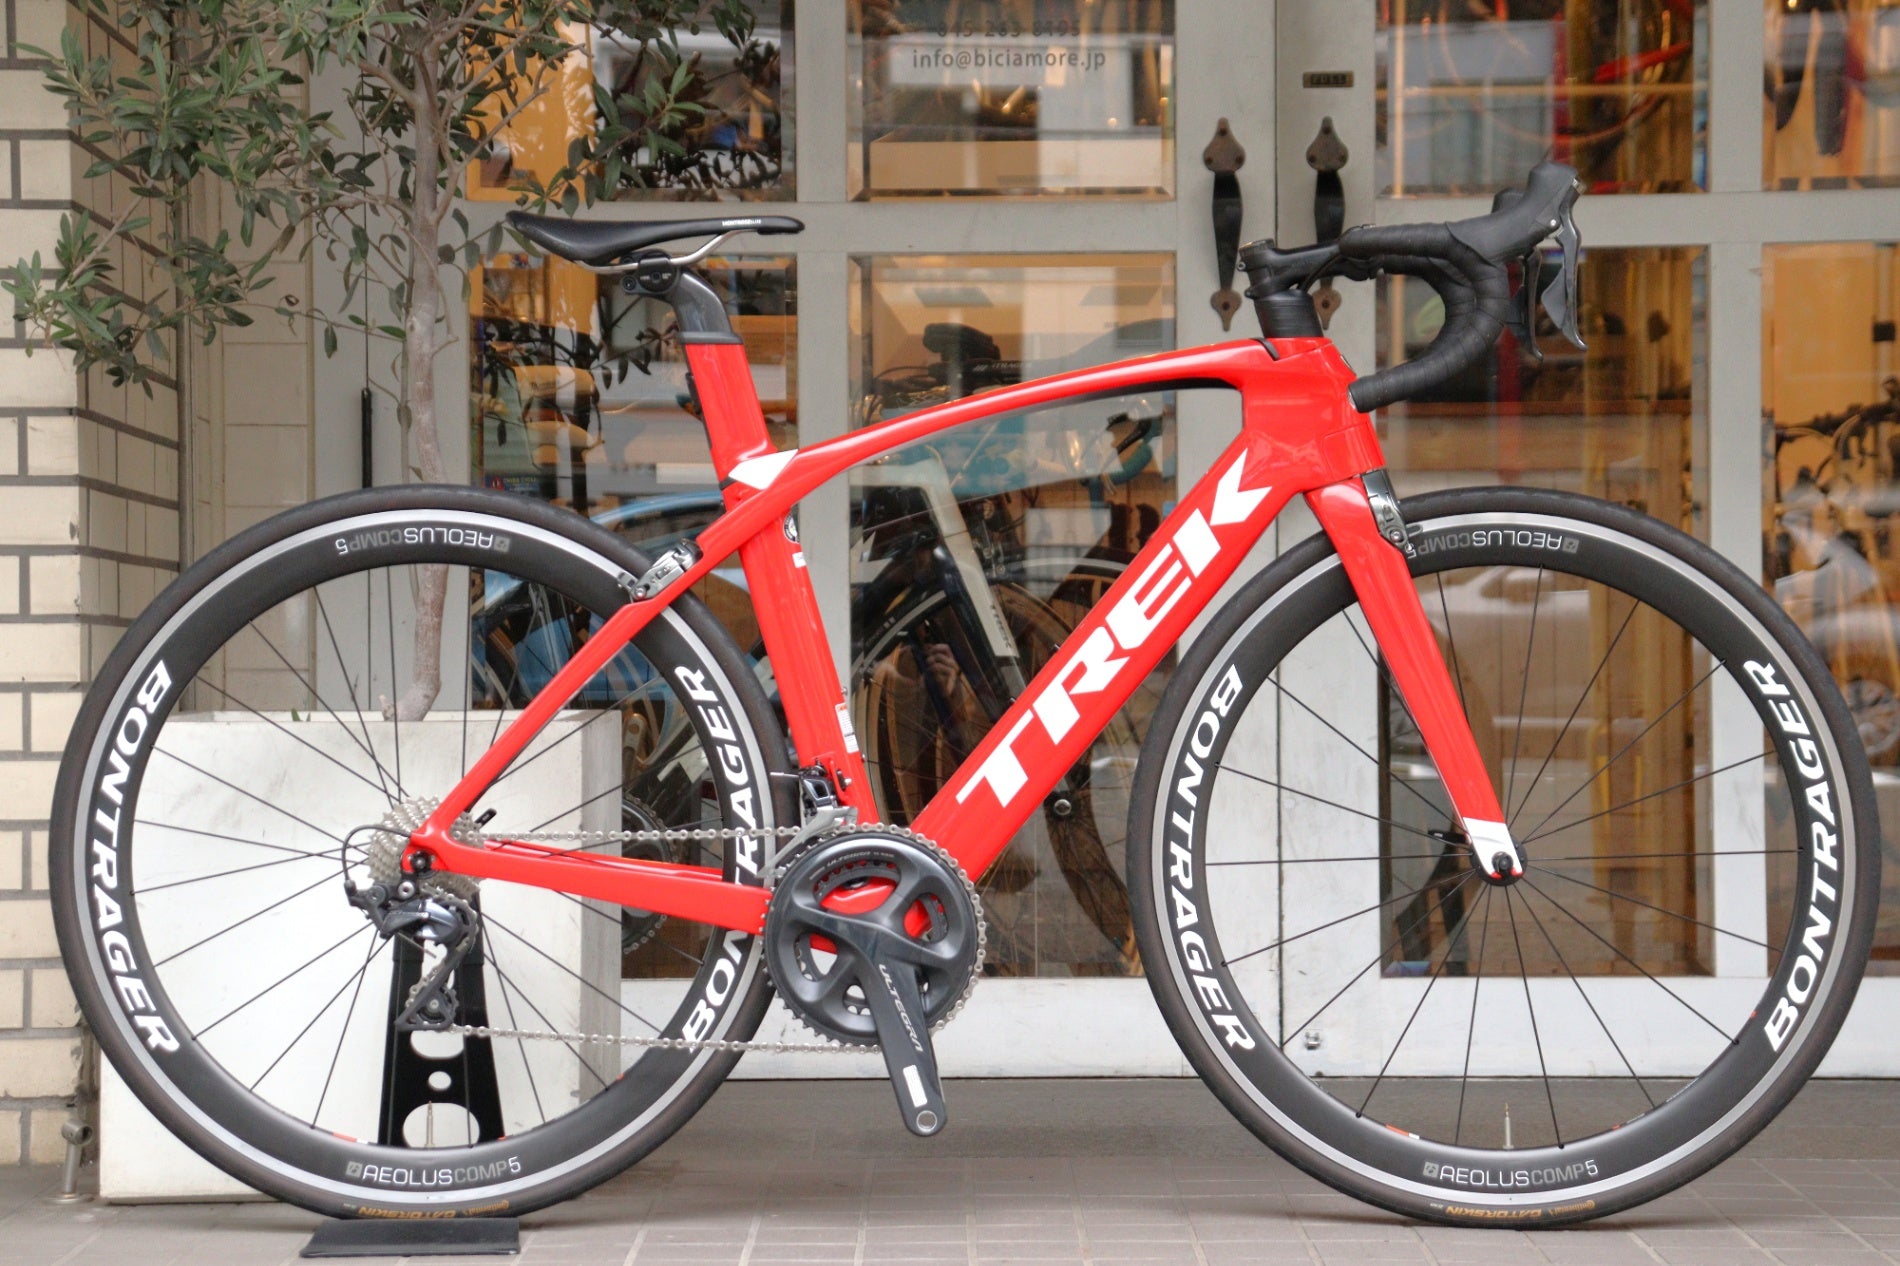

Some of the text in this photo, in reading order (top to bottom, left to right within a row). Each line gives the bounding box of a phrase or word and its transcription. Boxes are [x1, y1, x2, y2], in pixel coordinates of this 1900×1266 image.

[912, 48, 1106, 71] info@biciamore.jp
[955, 447, 1273, 808] TREK
[92, 659, 181, 1053] BONTRAGER
[878, 963, 924, 1052] ULTEGRA
[1169, 663, 1256, 1051] BONTRAGER
[1743, 659, 1839, 1052] BONTRAGER
[1445, 1206, 1542, 1218] GATORSKIN
